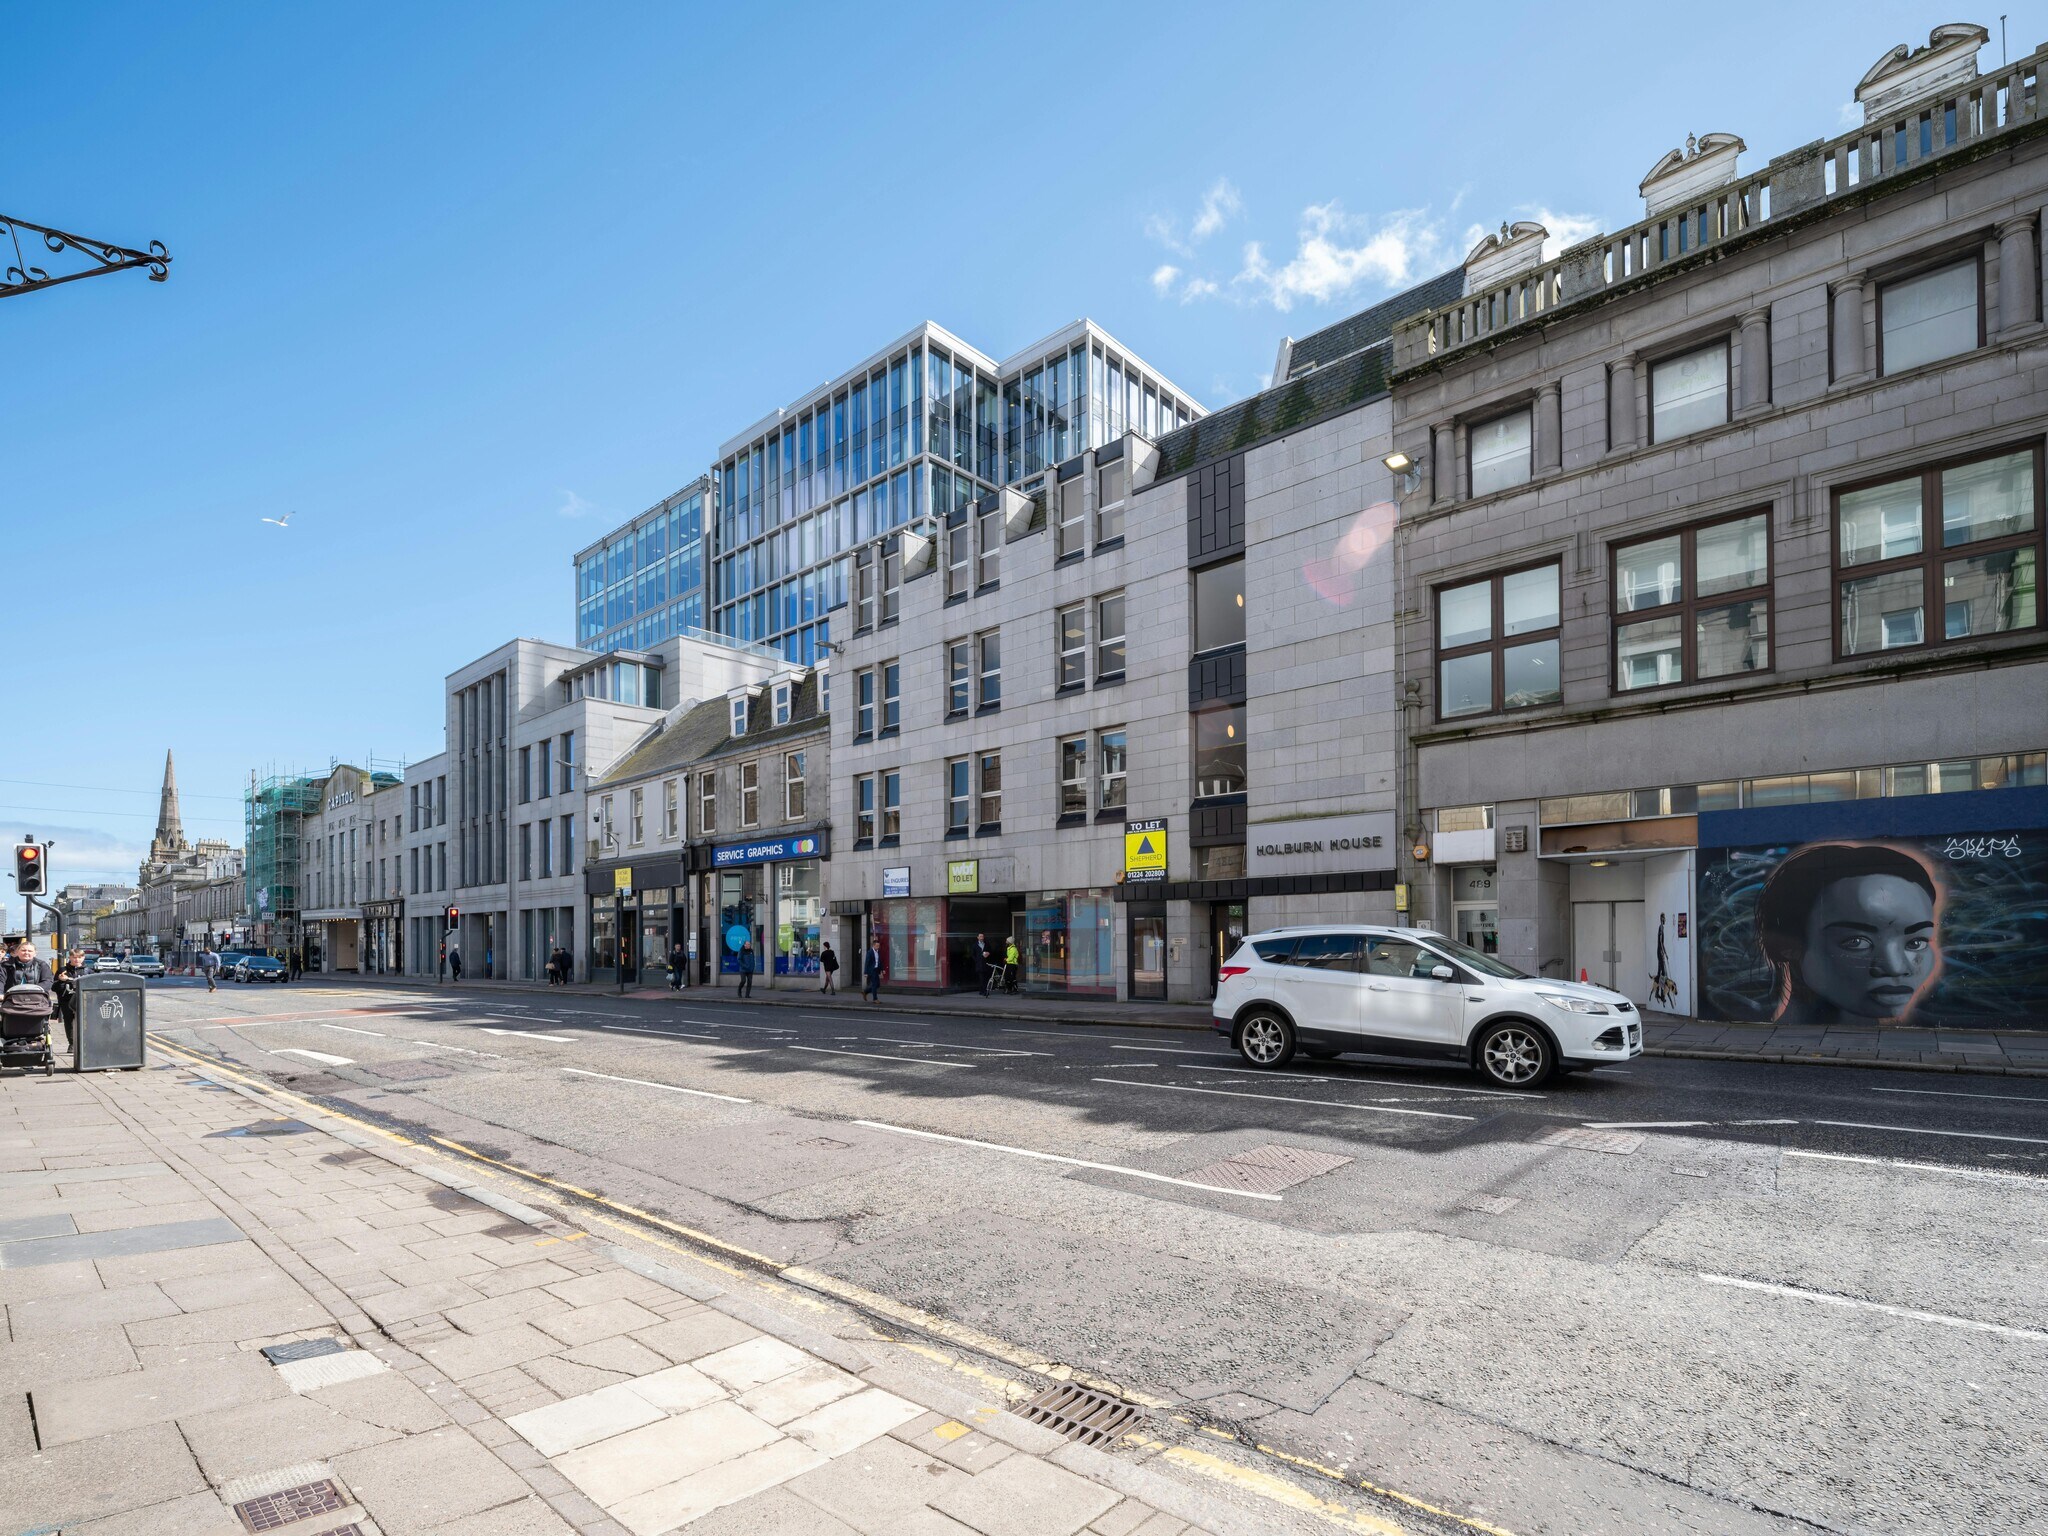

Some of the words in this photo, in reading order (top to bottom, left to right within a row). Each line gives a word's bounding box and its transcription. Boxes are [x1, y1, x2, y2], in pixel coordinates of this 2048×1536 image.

[328, 790, 355, 811] CAPITOL
[1130, 822, 1142, 831] TO
[1145, 821, 1160, 829] LET
[1256, 841, 1322, 856] HOLBURN
[1330, 836, 1382, 850] HOUSE
[717, 849, 744, 862] SERVICE
[747, 844, 783, 857] GRAPHICS
[1129, 854, 1162, 863] SHEPHERD
[953, 875, 961, 883] TO
[962, 874, 974, 882] LET
[1127, 871, 1143, 879] 01224
[1145, 870, 1165, 878] 202800
[1469, 879, 1491, 889] 489
